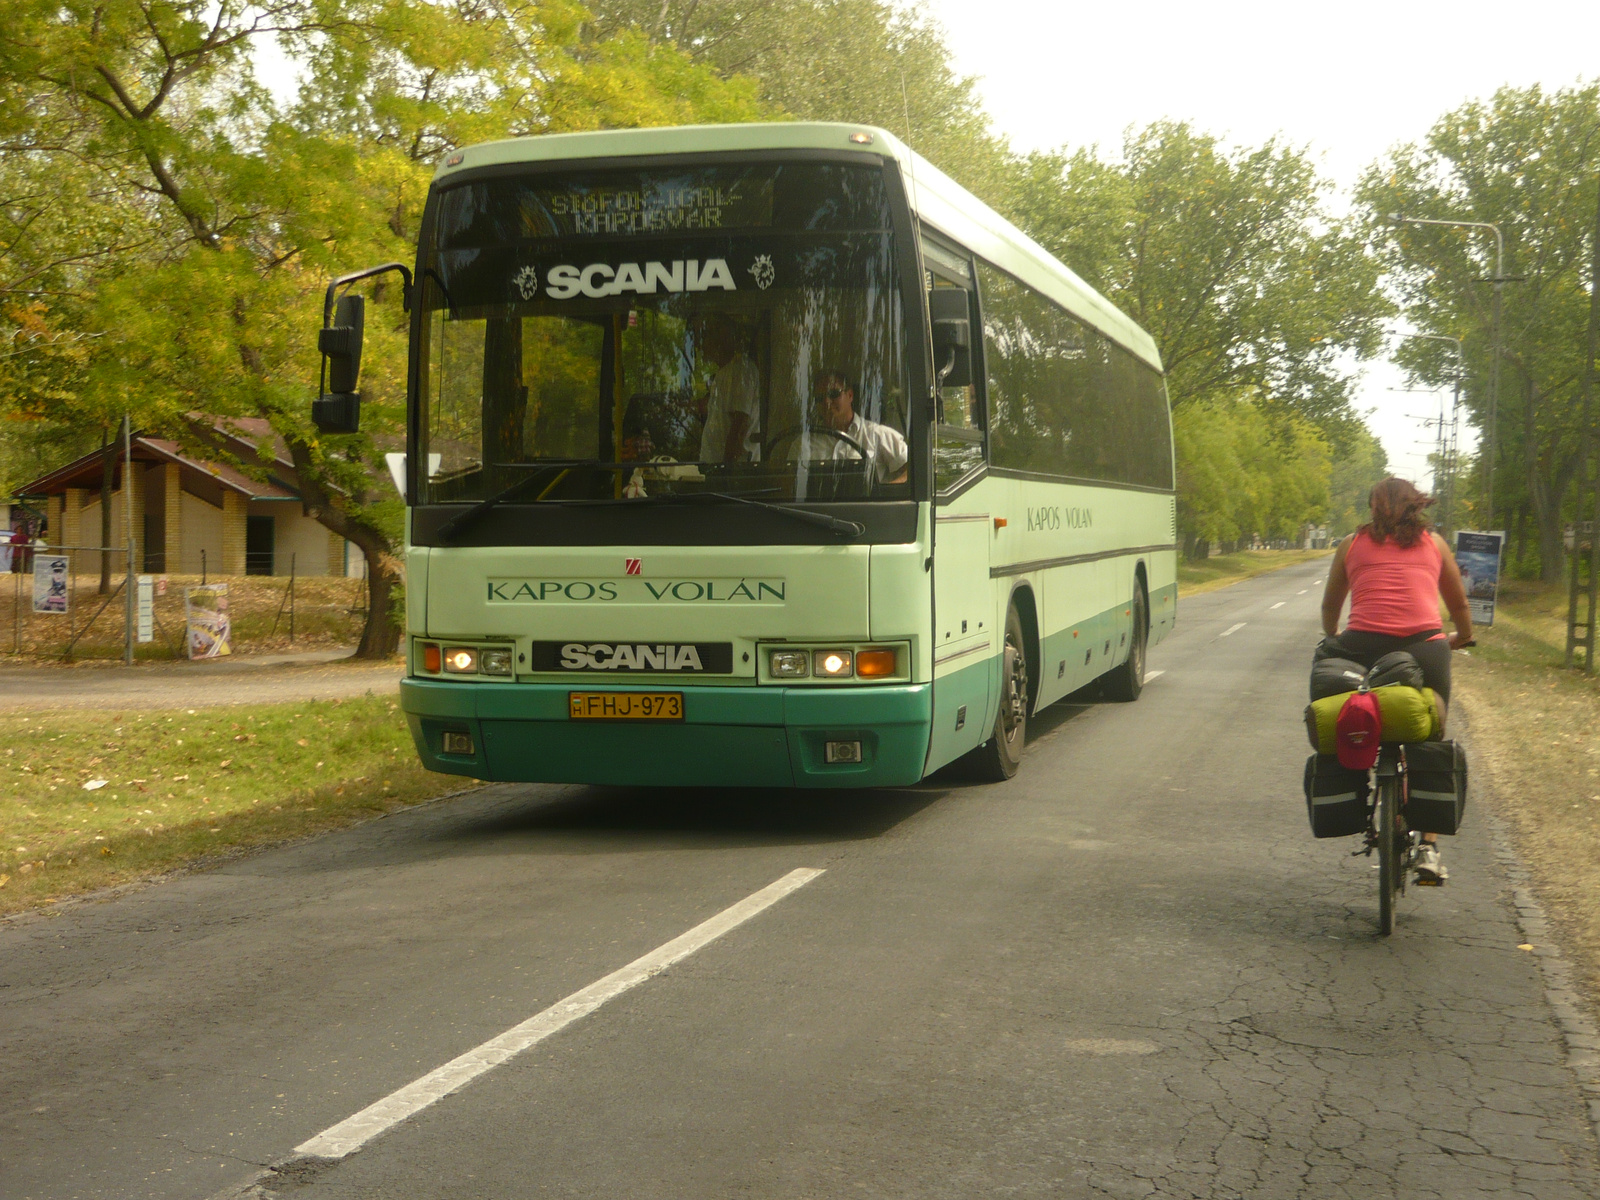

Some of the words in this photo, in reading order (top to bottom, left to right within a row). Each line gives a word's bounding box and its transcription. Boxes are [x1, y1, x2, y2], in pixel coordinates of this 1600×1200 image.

[545, 258, 737, 299] SCANIA
[1028, 506, 1060, 532] KAPOS
[488, 581, 618, 601] KAPOS
[644, 577, 785, 601] VOLÁN
[560, 643, 703, 671] SCANIA
[587, 696, 680, 715] FHJ-973
